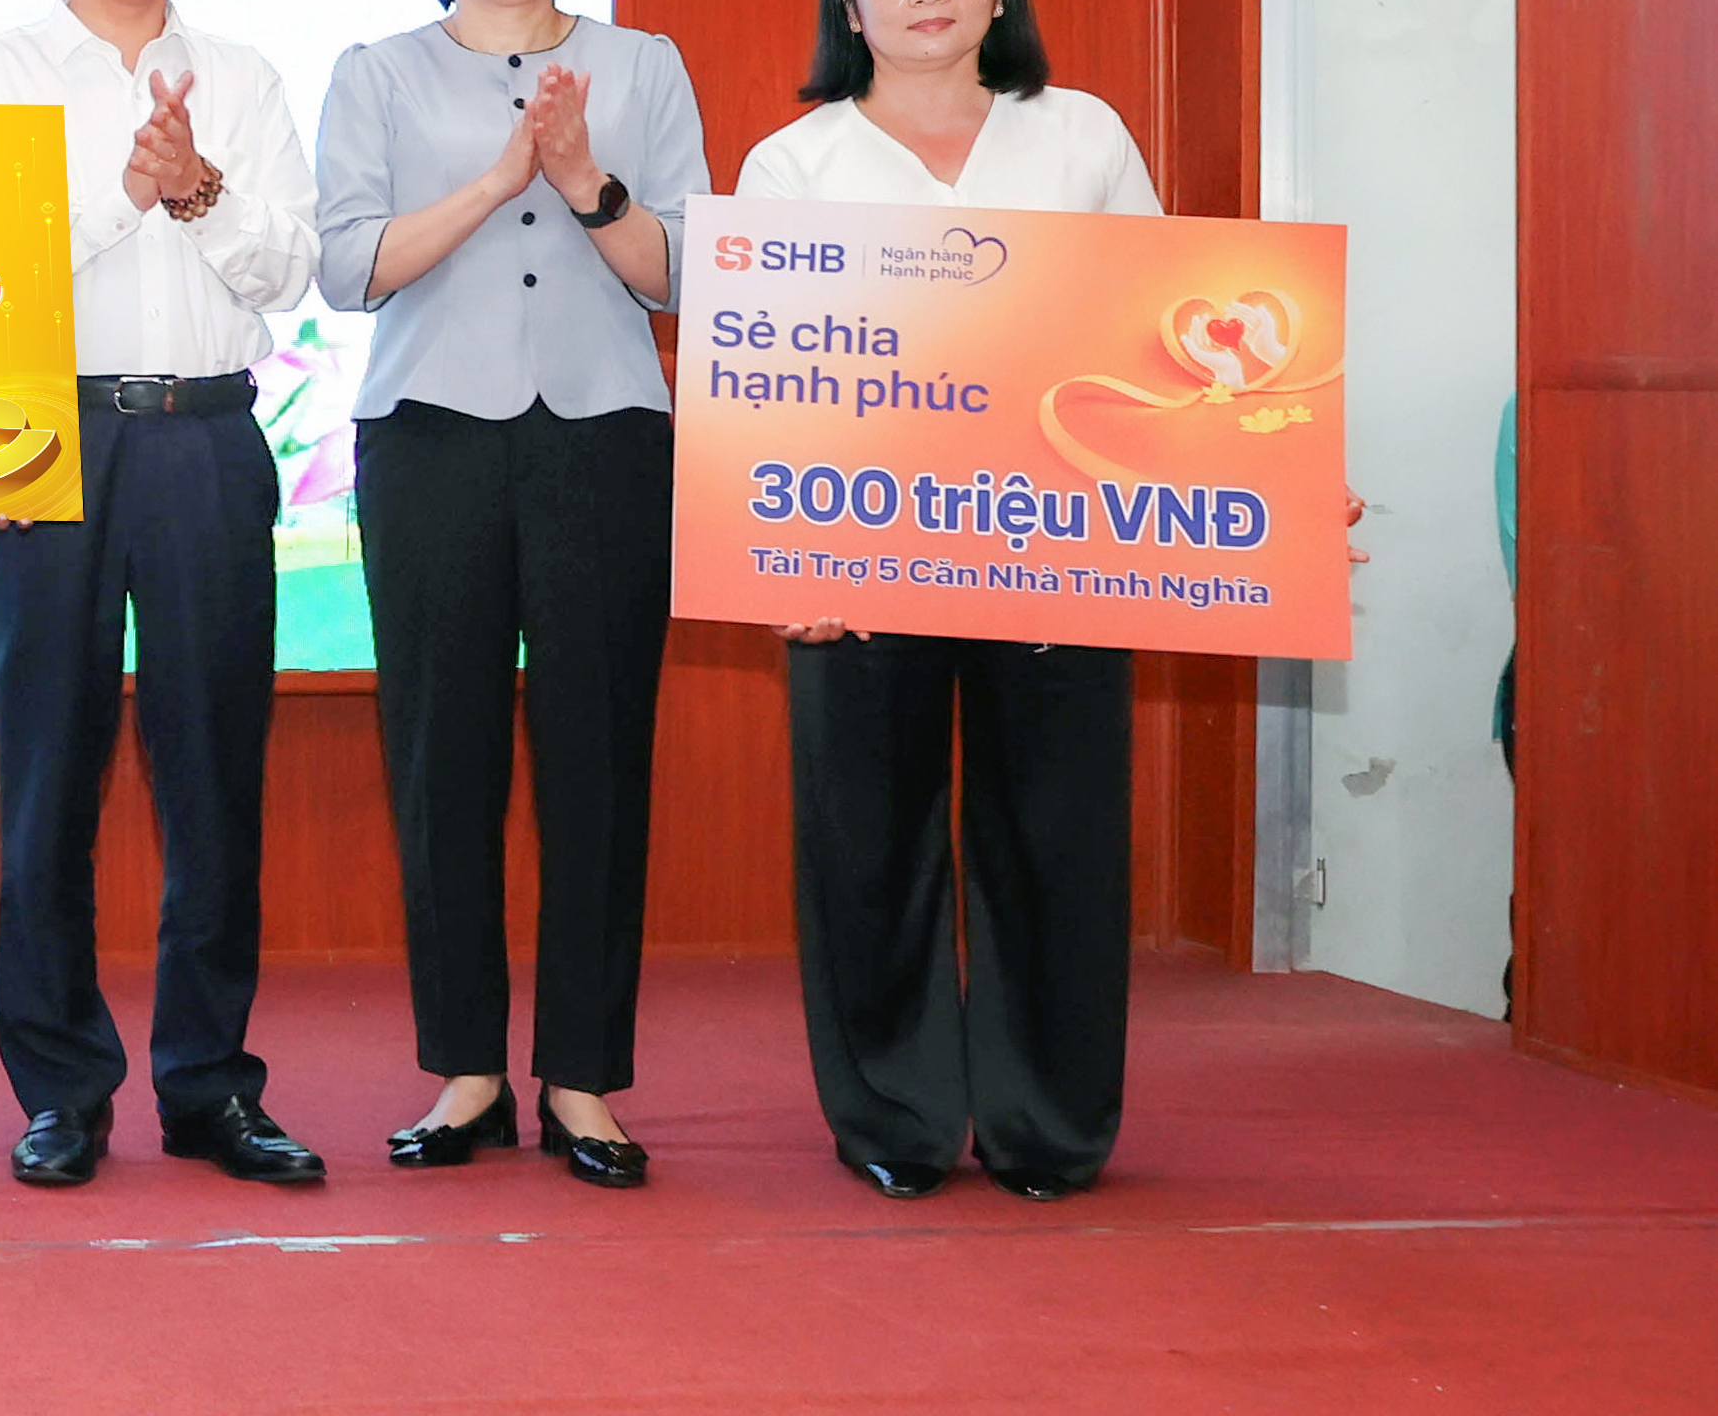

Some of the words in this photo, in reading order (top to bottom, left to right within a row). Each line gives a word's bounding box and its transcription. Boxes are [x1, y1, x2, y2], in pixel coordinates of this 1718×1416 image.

[760, 239, 845, 273] SHB
[880, 264, 925, 280] Hạnh
[930, 267, 974, 282] phúc
[881, 246, 926, 262] Ngân
[931, 248, 973, 265] hàng
[711, 309, 776, 350] Sẻ
[790, 315, 900, 356] chia
[709, 359, 841, 410] hạnh
[854, 372, 990, 417] phúc
[751, 461, 899, 526] 300
[913, 471, 1085, 550] triệu
[1100, 481, 1266, 548] VNĐ
[750, 547, 801, 576] Tài
[807, 552, 870, 586] Trợ
[878, 557, 899, 581] 5
[907, 557, 981, 587] Căn
[987, 562, 1059, 593] Nhà
[1066, 566, 1151, 599] Tình
[1161, 572, 1269, 607] Nghĩa
